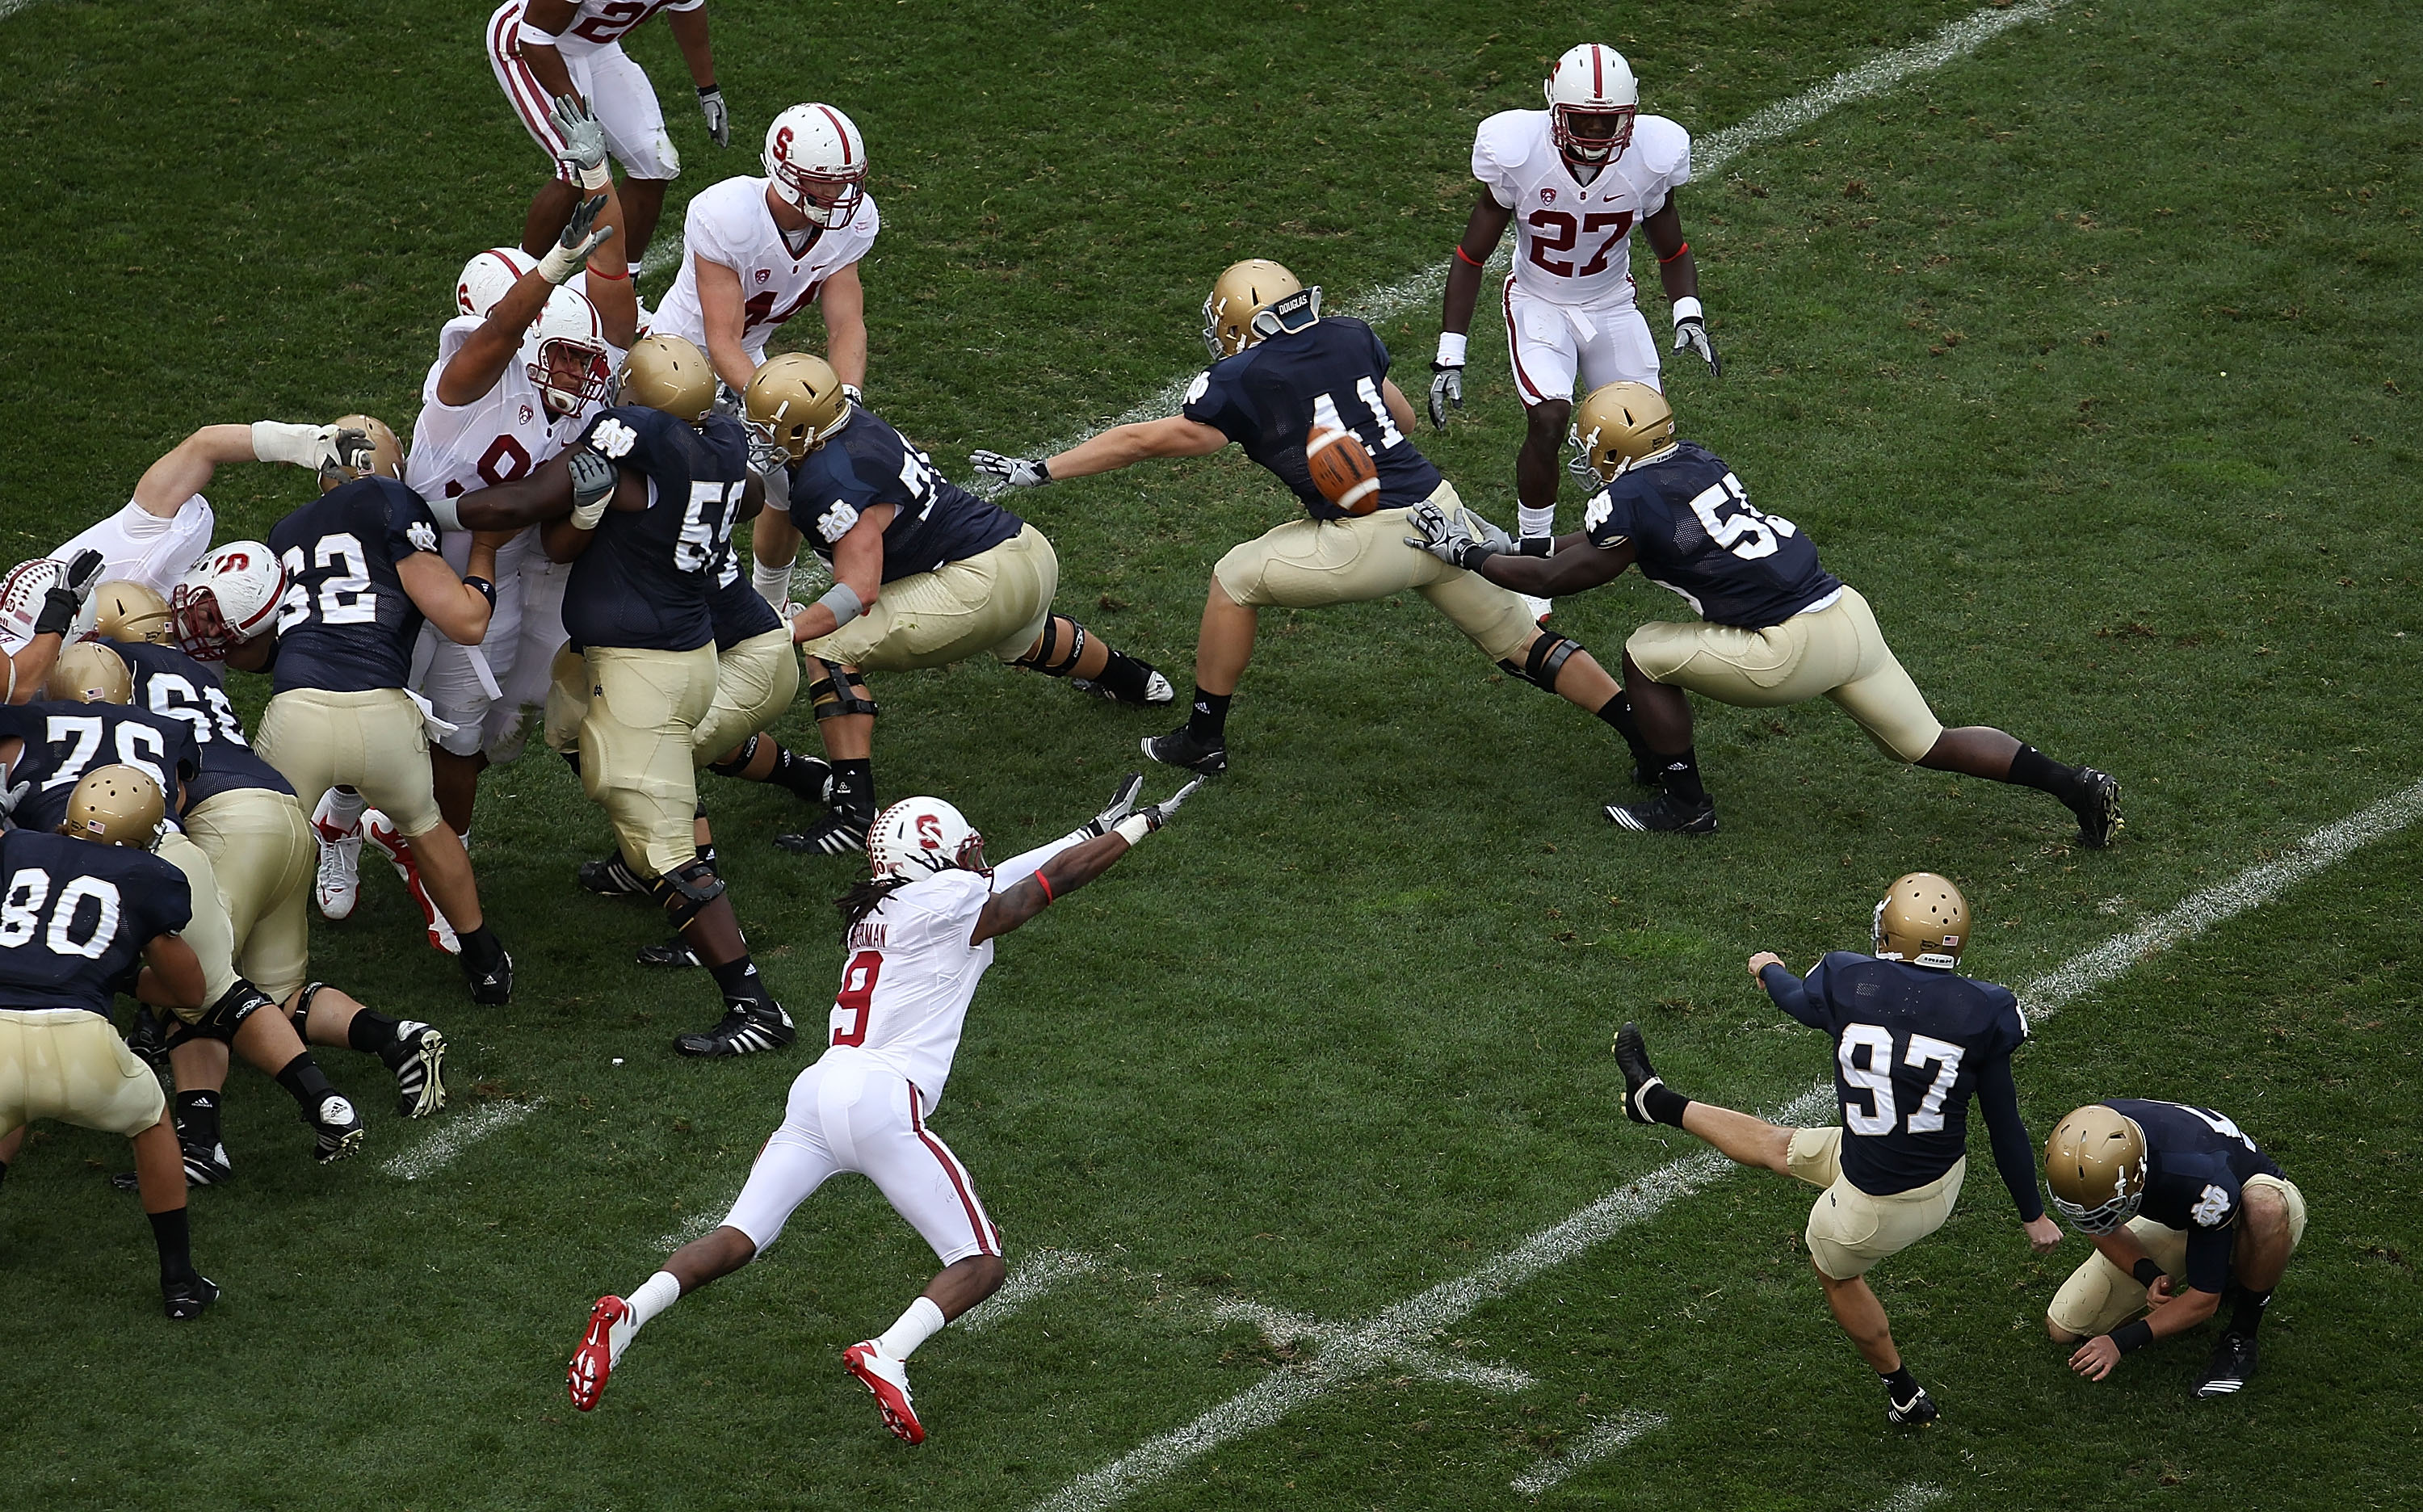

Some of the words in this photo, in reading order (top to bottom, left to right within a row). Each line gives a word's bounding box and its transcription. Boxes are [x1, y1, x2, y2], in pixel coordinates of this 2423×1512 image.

[773, 125, 793, 161] S
[1528, 209, 1634, 279] 27
[215, 553, 249, 574] S
[916, 813, 943, 850] S
[0, 867, 120, 960] 80
[833, 950, 884, 1048] 9
[1837, 1023, 1966, 1136] 97
